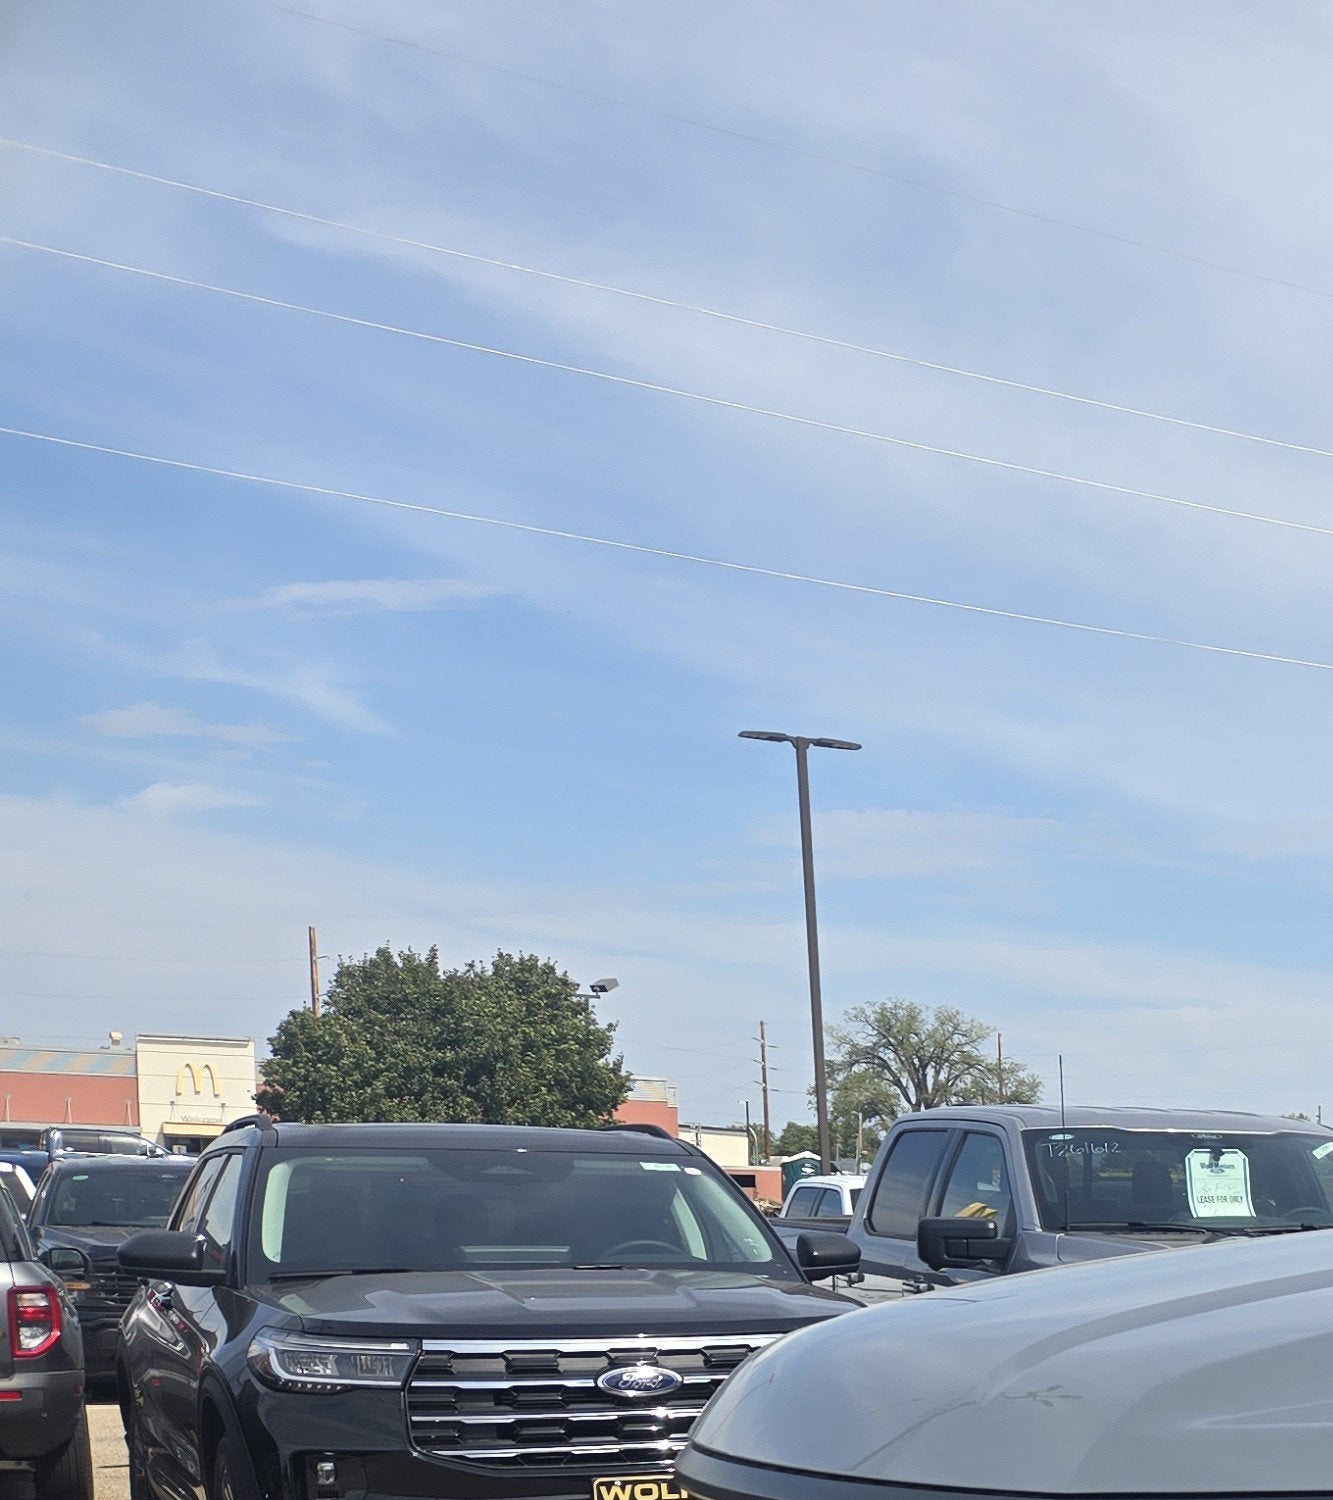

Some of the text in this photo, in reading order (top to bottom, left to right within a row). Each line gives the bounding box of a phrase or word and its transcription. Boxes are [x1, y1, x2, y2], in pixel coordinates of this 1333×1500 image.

[1196, 1195, 1244, 1204] LEASE FOR ONLY
